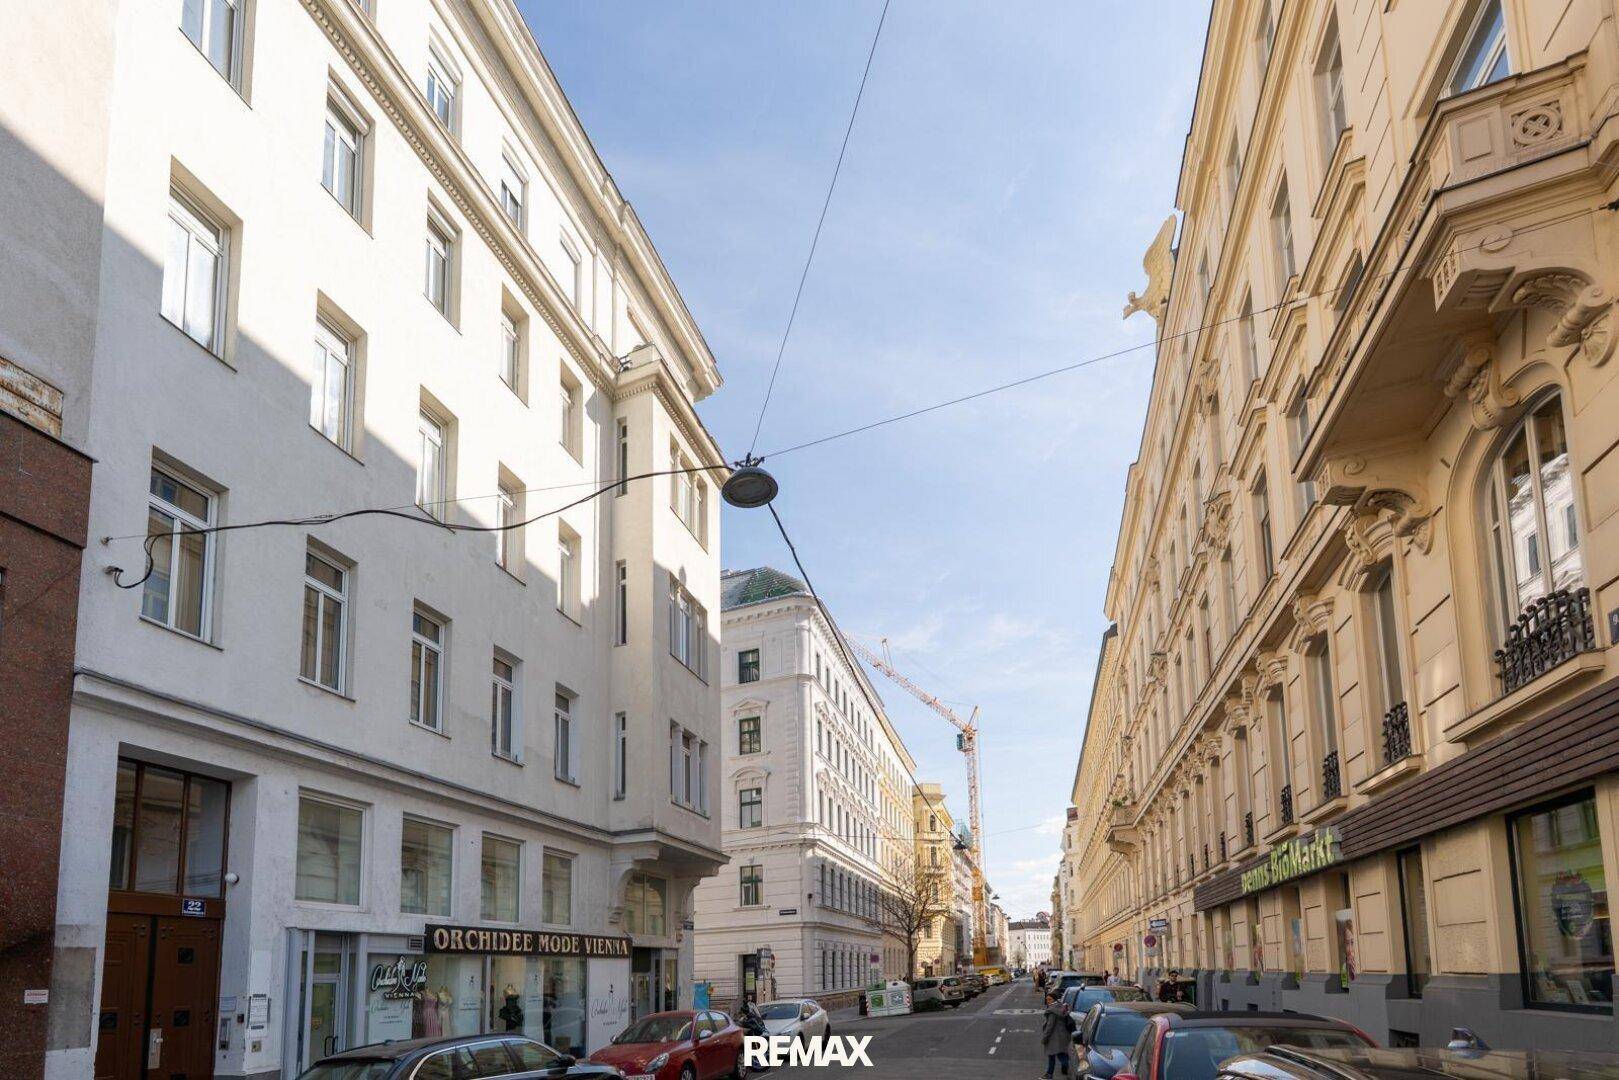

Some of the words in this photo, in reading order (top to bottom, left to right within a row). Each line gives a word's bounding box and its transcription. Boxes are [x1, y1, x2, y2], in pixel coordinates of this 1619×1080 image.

[188, 900, 201, 911] 22
[433, 928, 533, 951] ORCHIDEE
[538, 934, 580, 954] MODE
[584, 937, 628, 955] VIENNA
